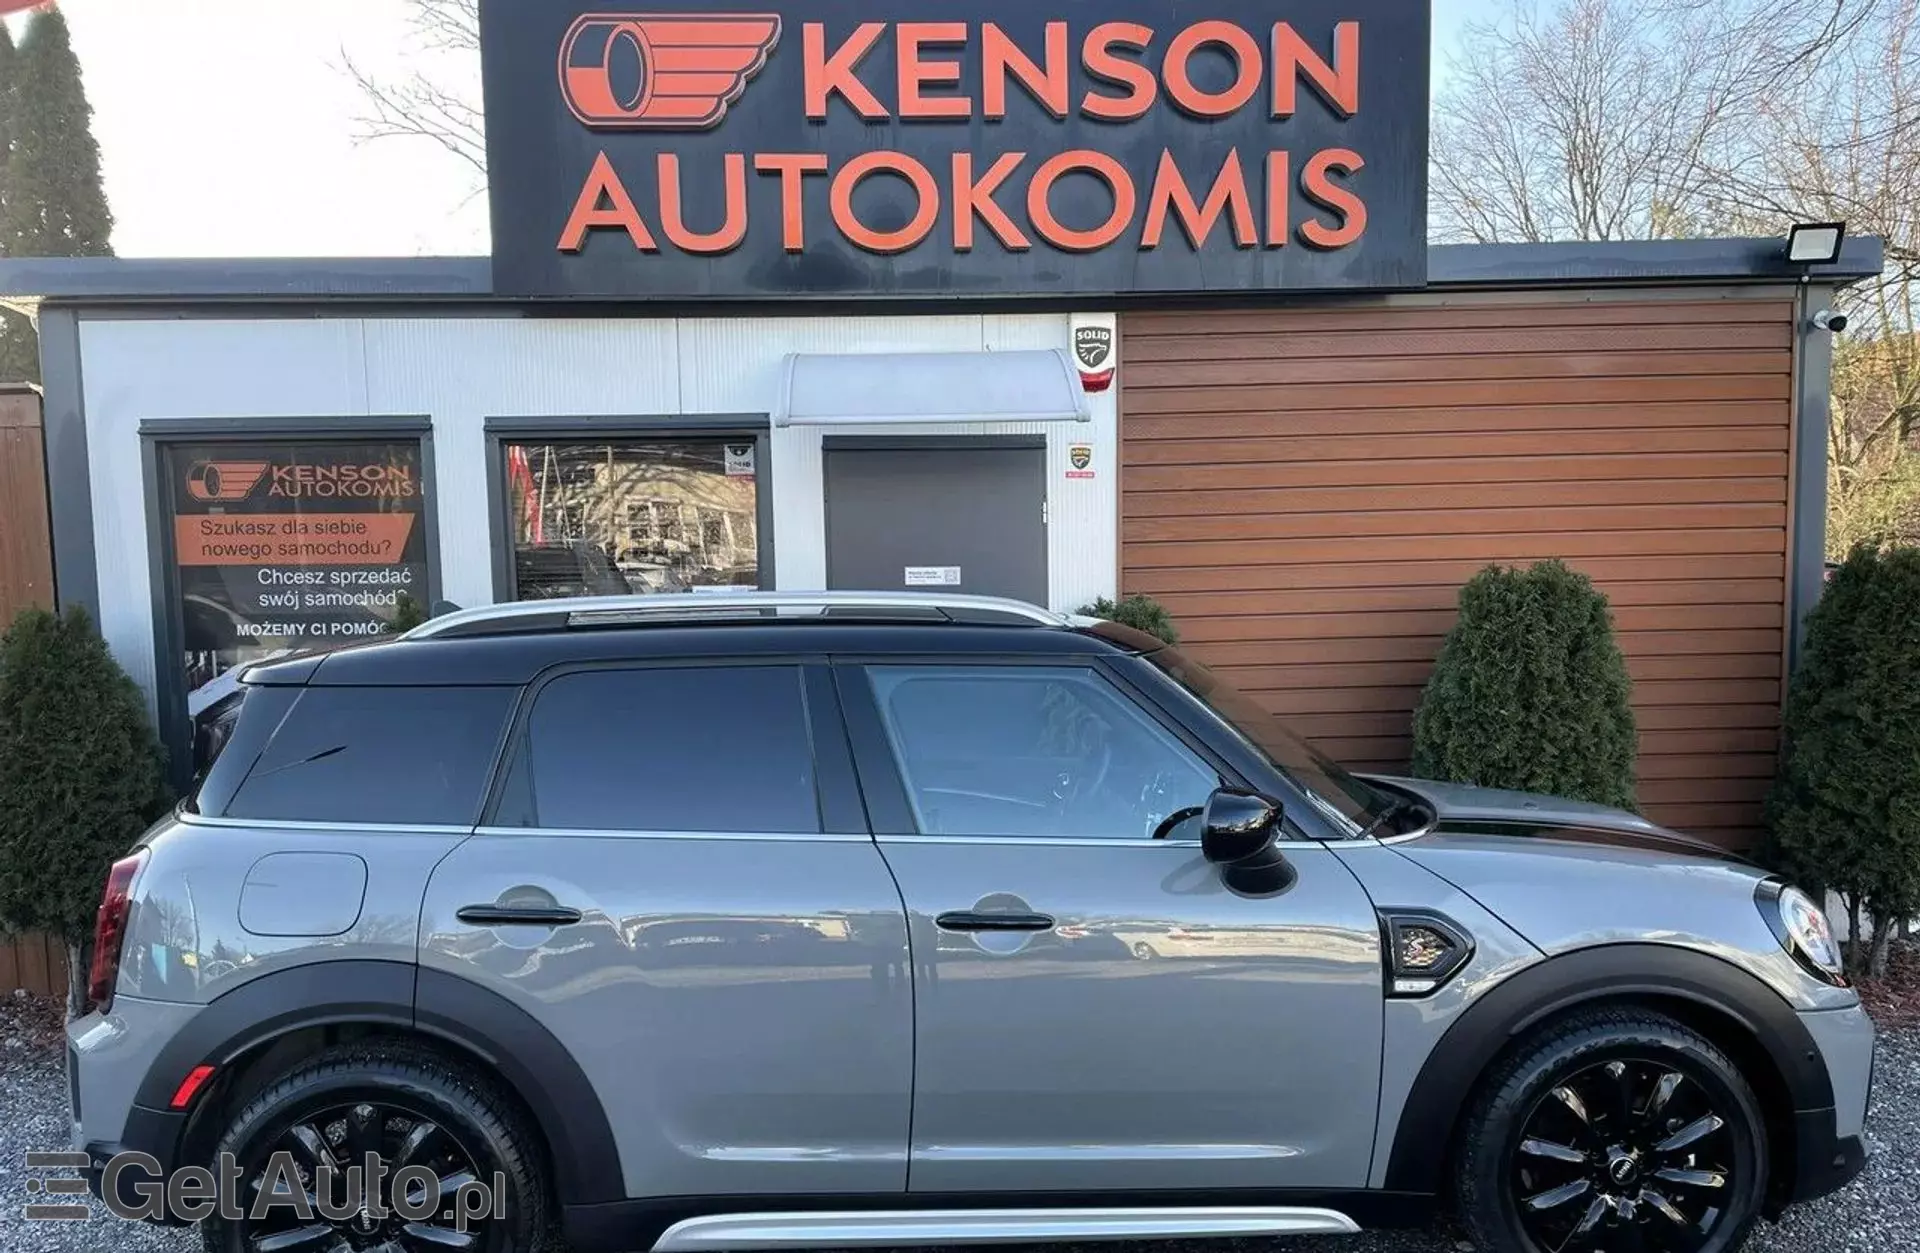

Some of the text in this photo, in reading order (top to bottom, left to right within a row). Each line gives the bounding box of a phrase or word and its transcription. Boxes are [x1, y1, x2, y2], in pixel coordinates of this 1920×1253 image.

[803, 19, 1361, 121] KENSON
[557, 147, 1367, 253] AUTOKOMIS
[1076, 329, 1110, 341] SOLID
[271, 465, 409, 481] KENSON
[268, 480, 414, 497] AUTOKOMIS
[200, 518, 367, 536] Szukasz dla siebie
[201, 539, 392, 561] nowego samochodu?
[257, 567, 412, 587] Chcesz sprzedać
[258, 589, 408, 610] swój samochód
[236, 620, 306, 637] MOŻEMY
[311, 622, 327, 636] CI
